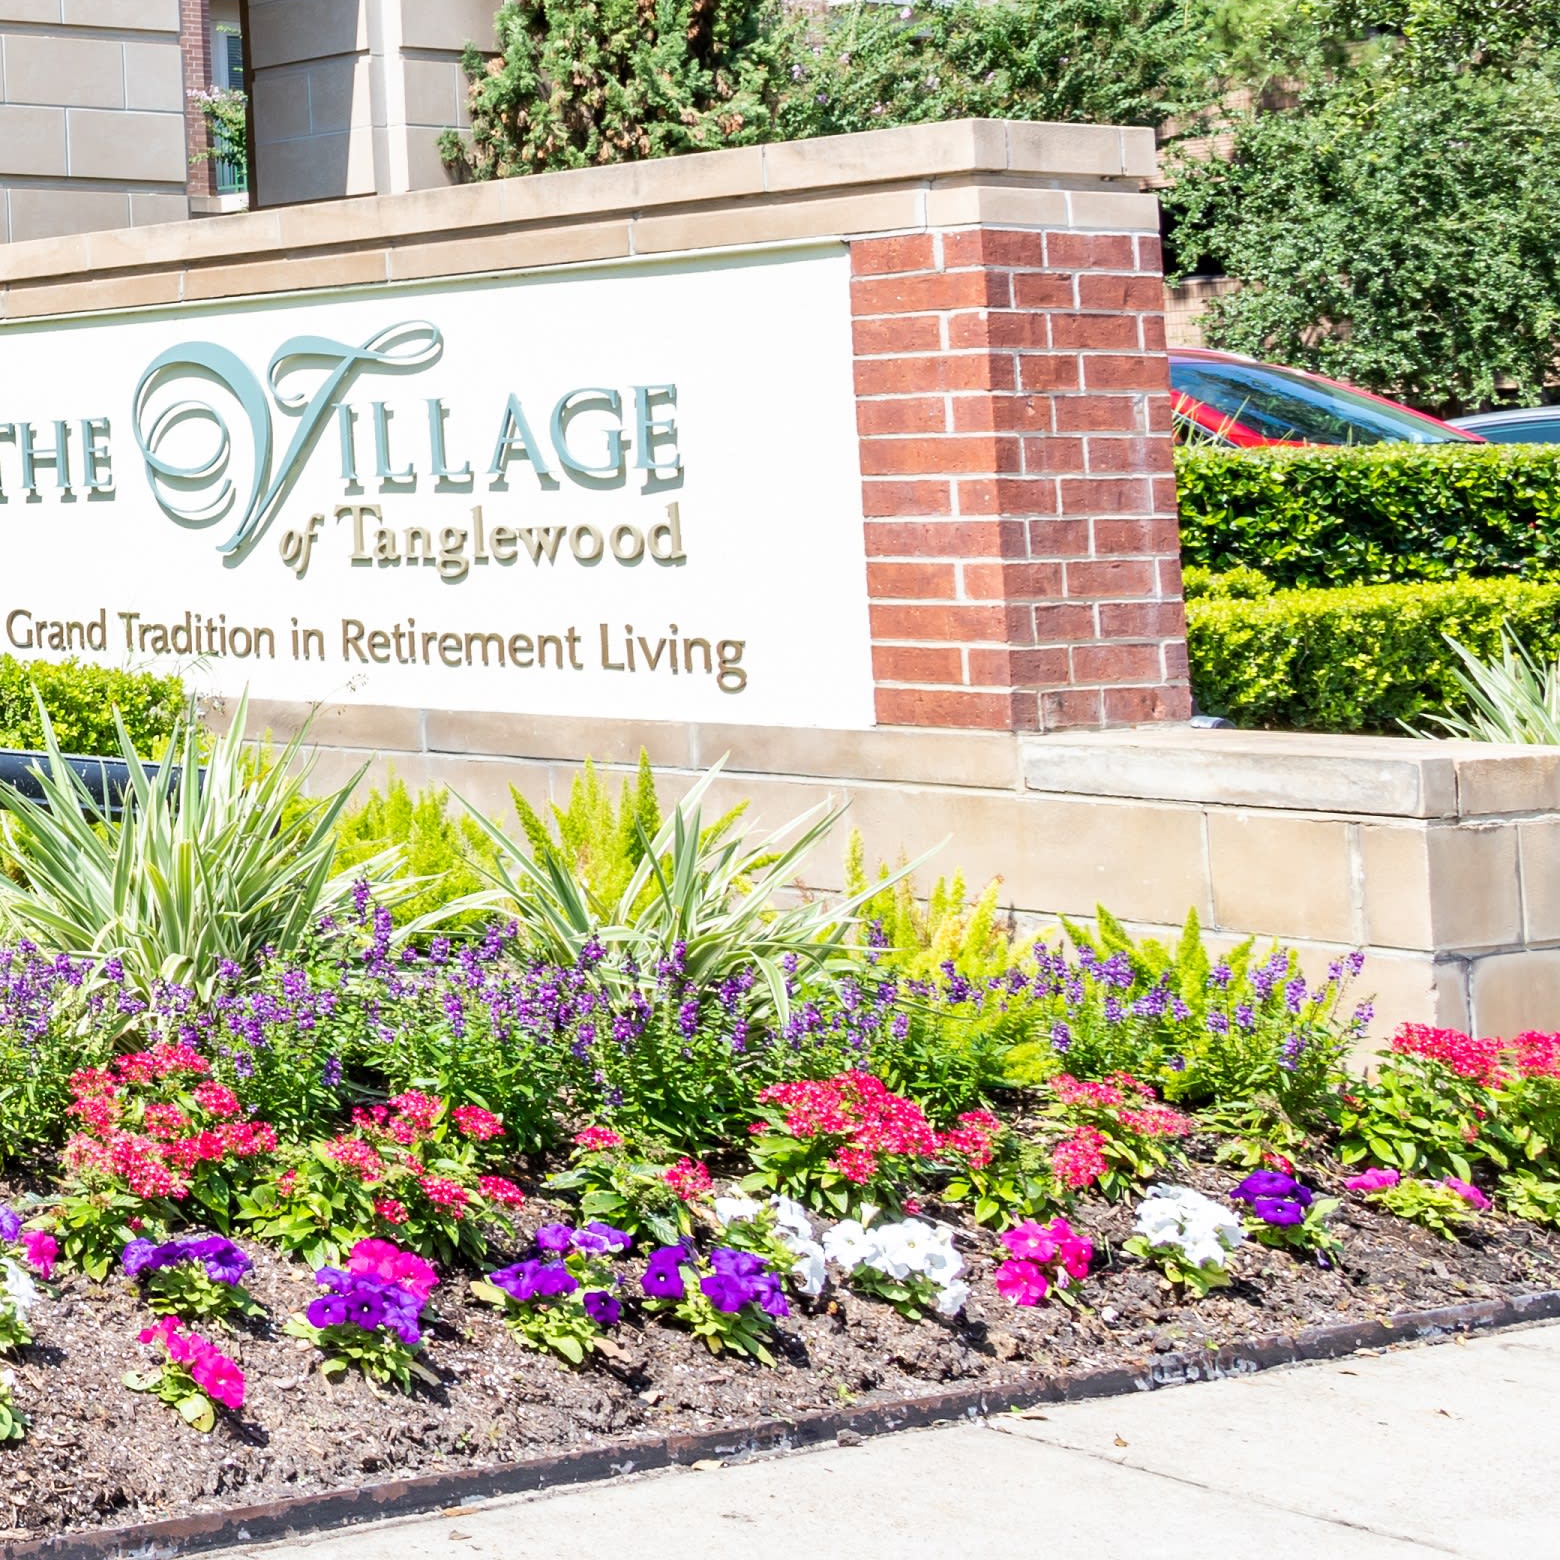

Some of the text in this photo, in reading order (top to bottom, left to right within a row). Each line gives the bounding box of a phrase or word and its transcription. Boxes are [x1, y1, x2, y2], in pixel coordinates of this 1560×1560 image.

[132, 320, 681, 553] VILLAGE
[279, 502, 686, 581] of Tanglewood
[6, 608, 107, 652] Grand
[117, 610, 275, 659] Tradition
[290, 617, 325, 661] in
[341, 617, 584, 670] Retirement
[599, 622, 749, 694] Living
